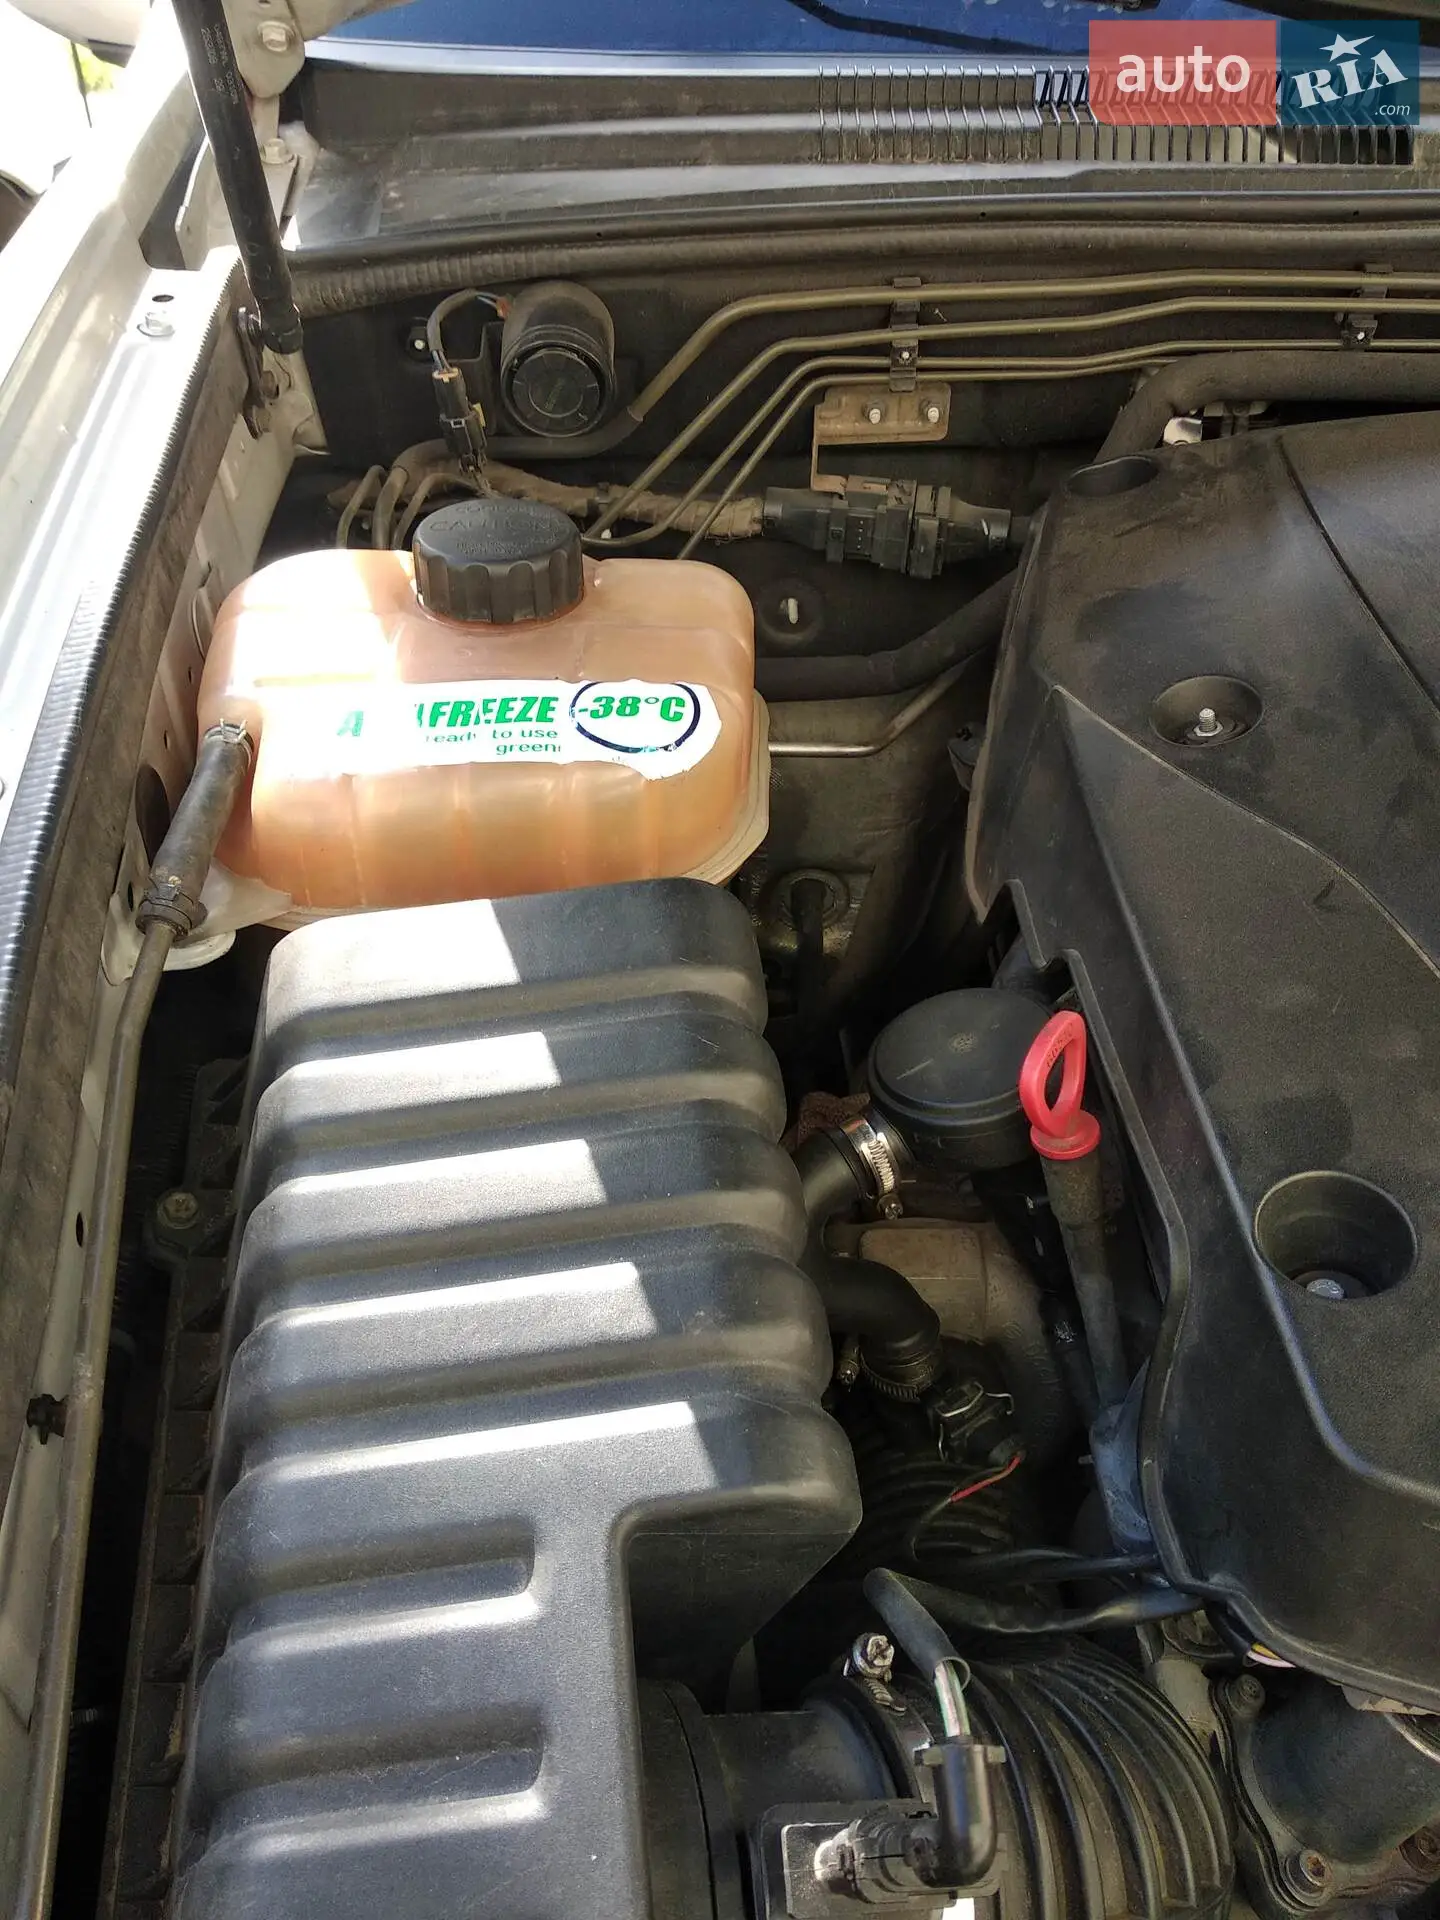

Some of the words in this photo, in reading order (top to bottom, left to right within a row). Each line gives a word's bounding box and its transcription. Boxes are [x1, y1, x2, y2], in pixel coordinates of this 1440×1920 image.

[578, 695, 686, 722] -38°C
[492, 729, 513, 739] to
[521, 728, 559, 739] use
[496, 743, 561, 755] green
